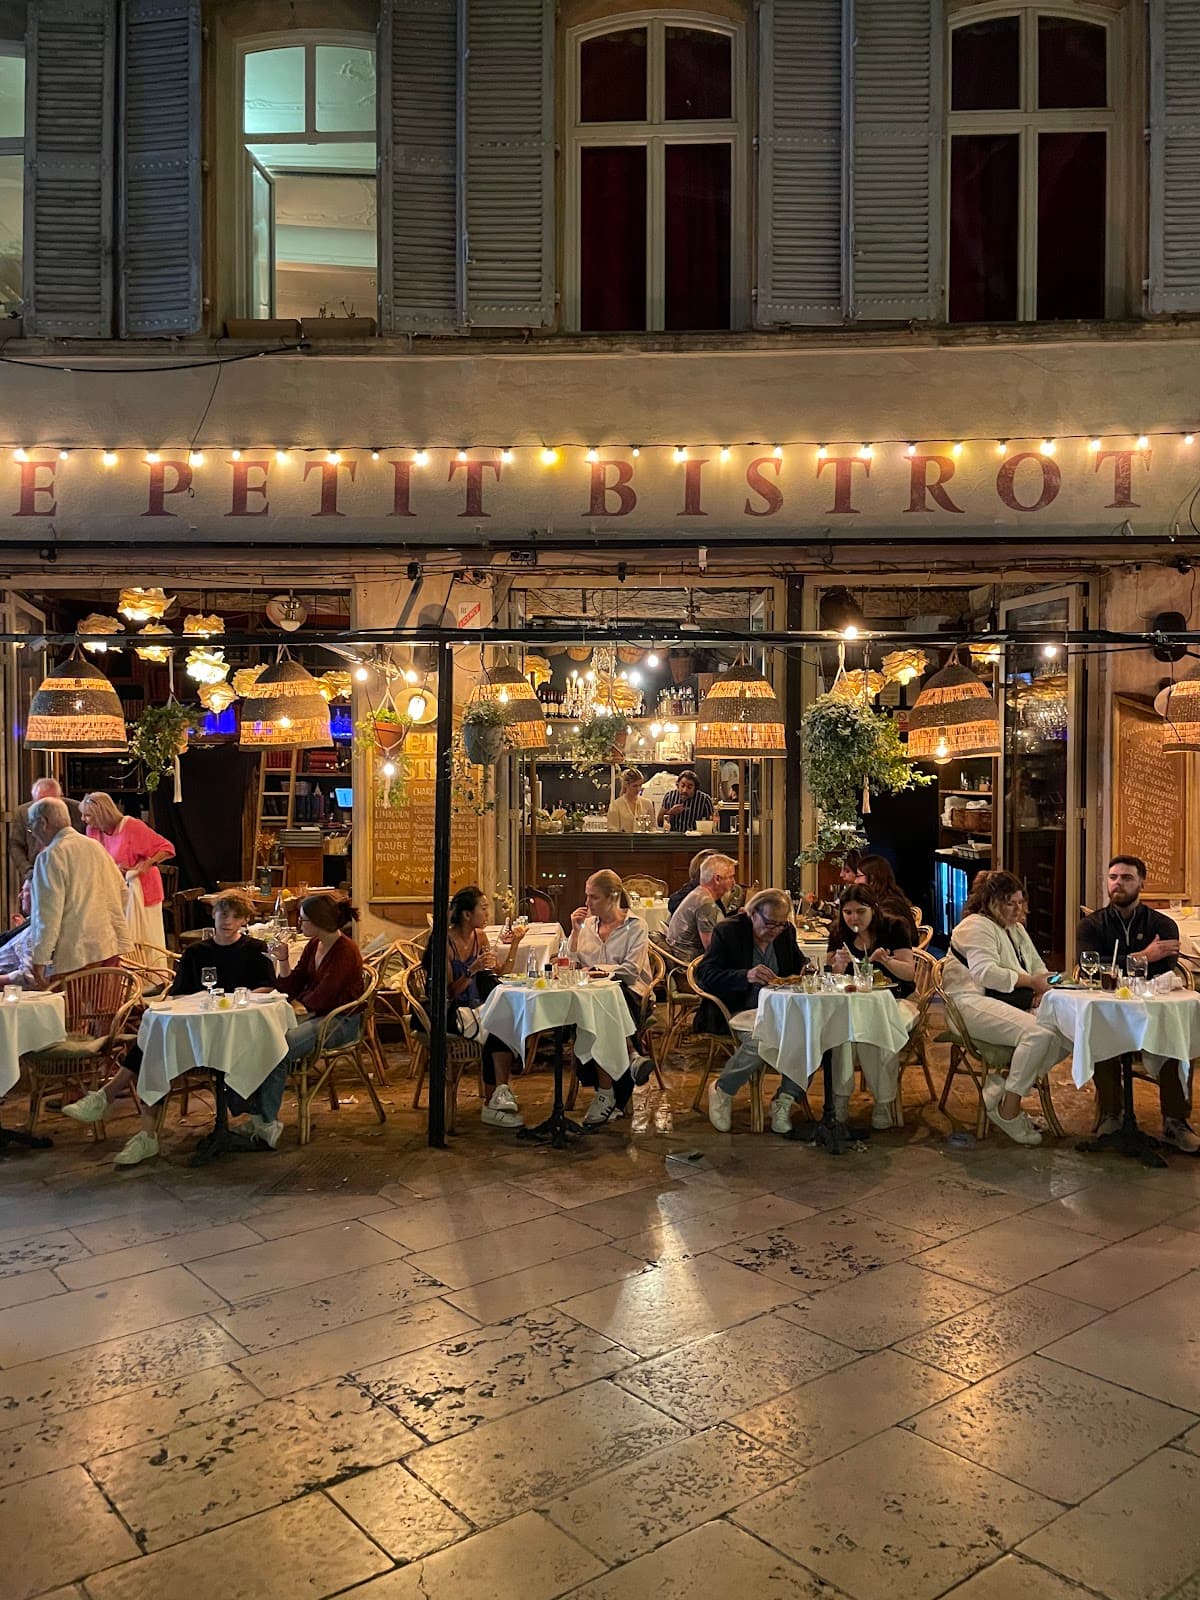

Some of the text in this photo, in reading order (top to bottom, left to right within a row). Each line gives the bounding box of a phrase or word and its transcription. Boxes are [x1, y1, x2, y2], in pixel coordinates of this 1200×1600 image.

[141, 460, 501, 517] PETIT
[582, 450, 1153, 517] BISTROT
[377, 841, 408, 851] DAUBE
